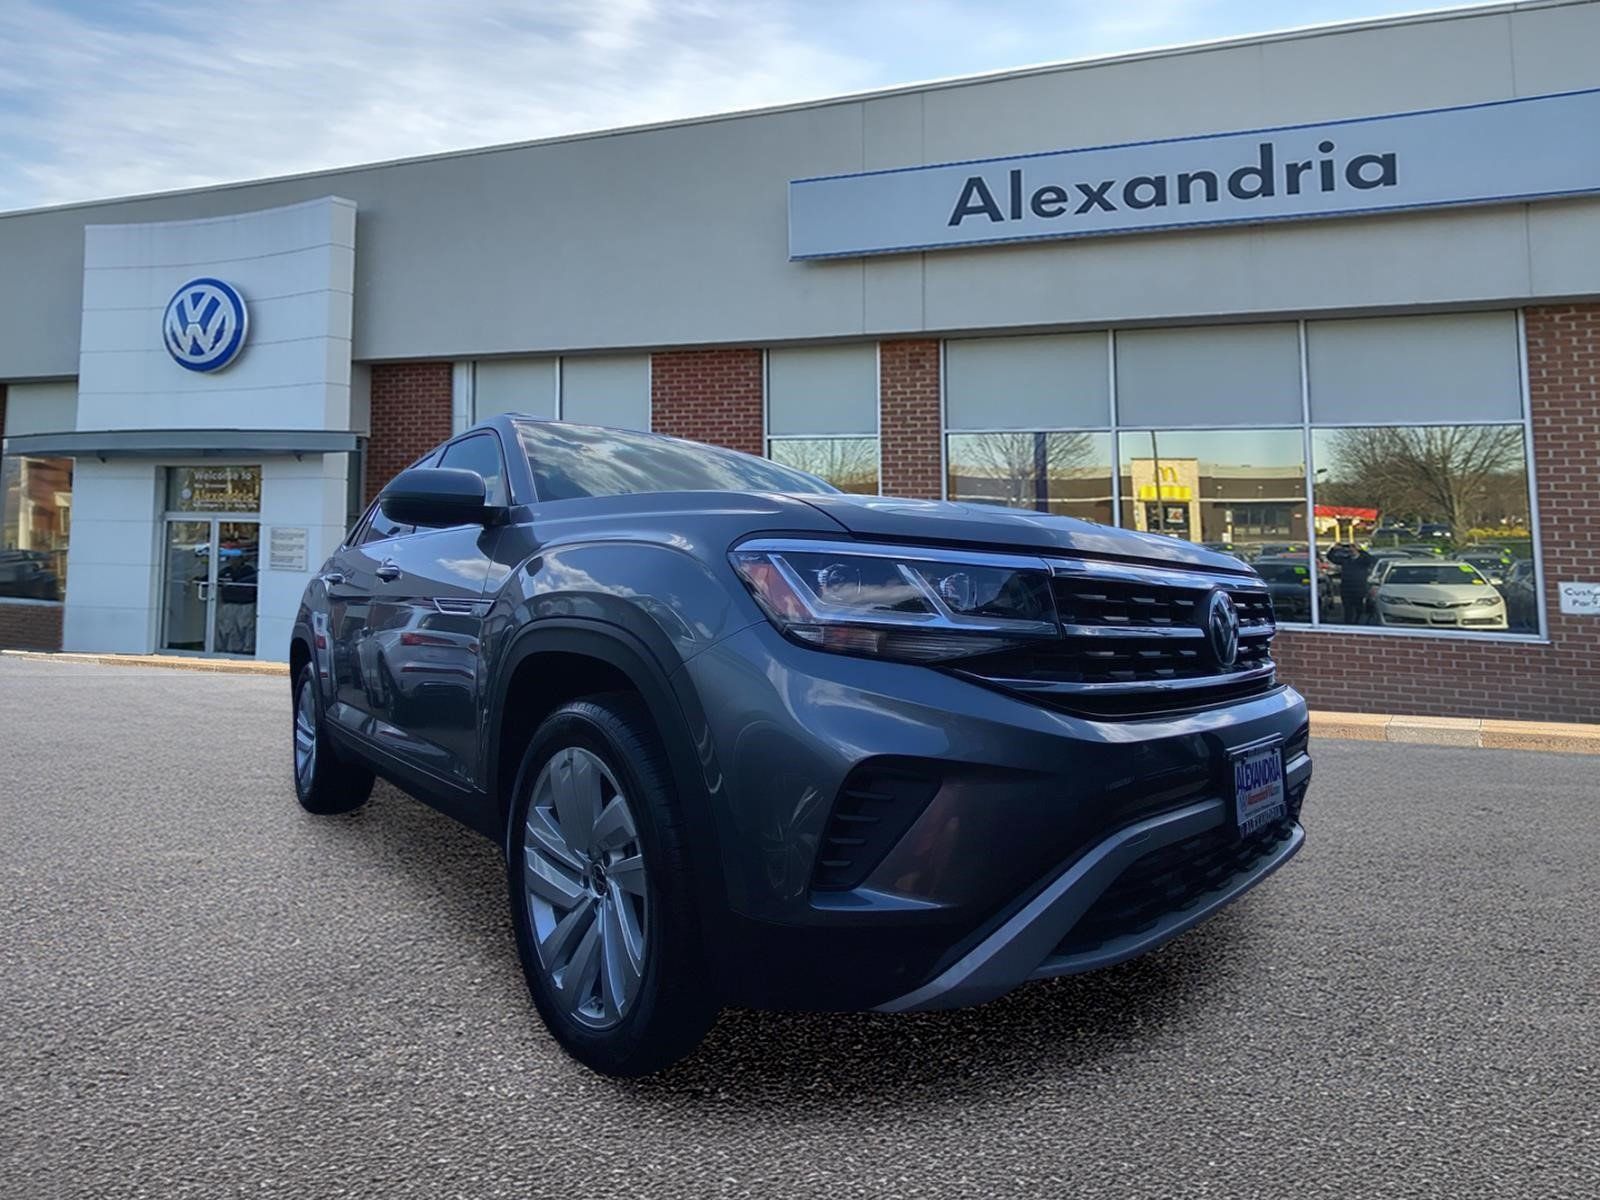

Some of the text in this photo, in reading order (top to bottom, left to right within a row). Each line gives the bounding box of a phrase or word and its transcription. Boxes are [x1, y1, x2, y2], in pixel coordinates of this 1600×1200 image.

[948, 141, 1398, 226] Alexandria
[164, 281, 242, 368] VW
[1236, 754, 1281, 795] ALEXANDRIA
